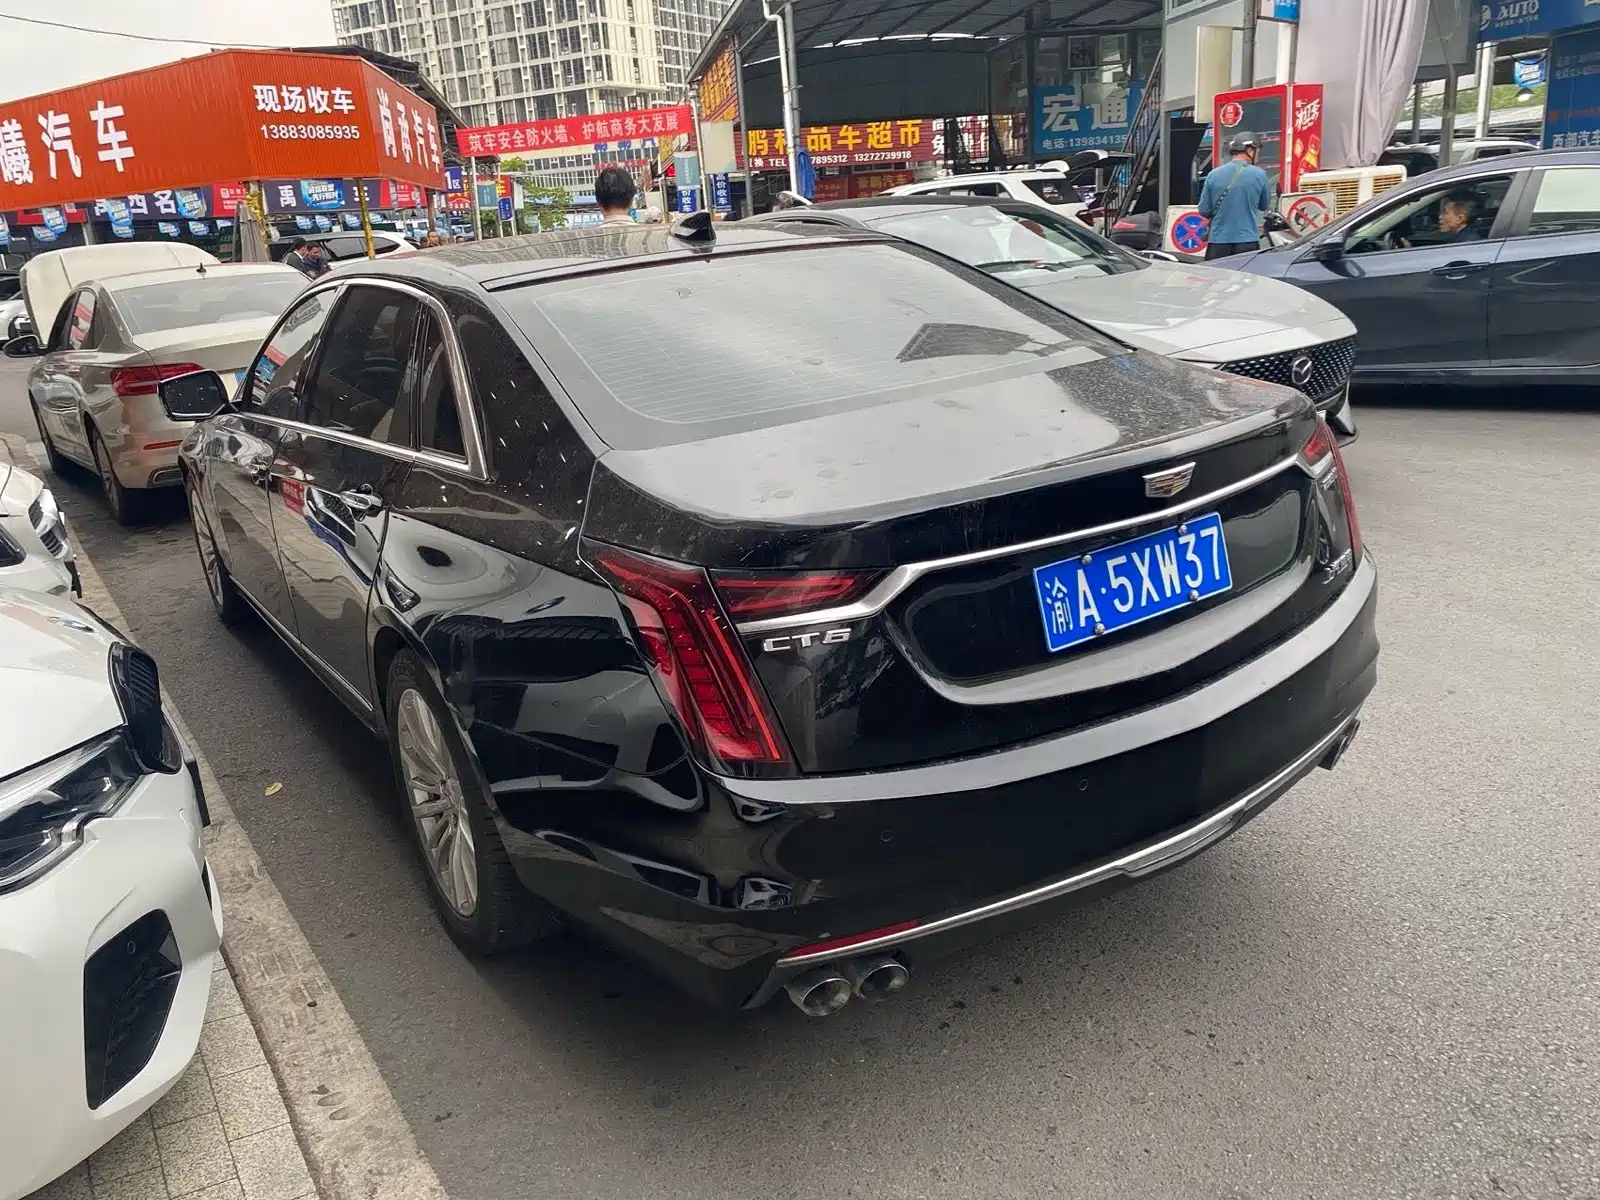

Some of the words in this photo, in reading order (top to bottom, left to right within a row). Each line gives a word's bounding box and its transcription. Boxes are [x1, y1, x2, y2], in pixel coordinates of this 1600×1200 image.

[253, 85, 355, 114] 现场收车
[261, 124, 360, 139] 13883085935
[853, 150, 912, 162] 13272739918
[1045, 526, 1220, 634] 渝A·5XW37
[763, 627, 852, 652] CT6
